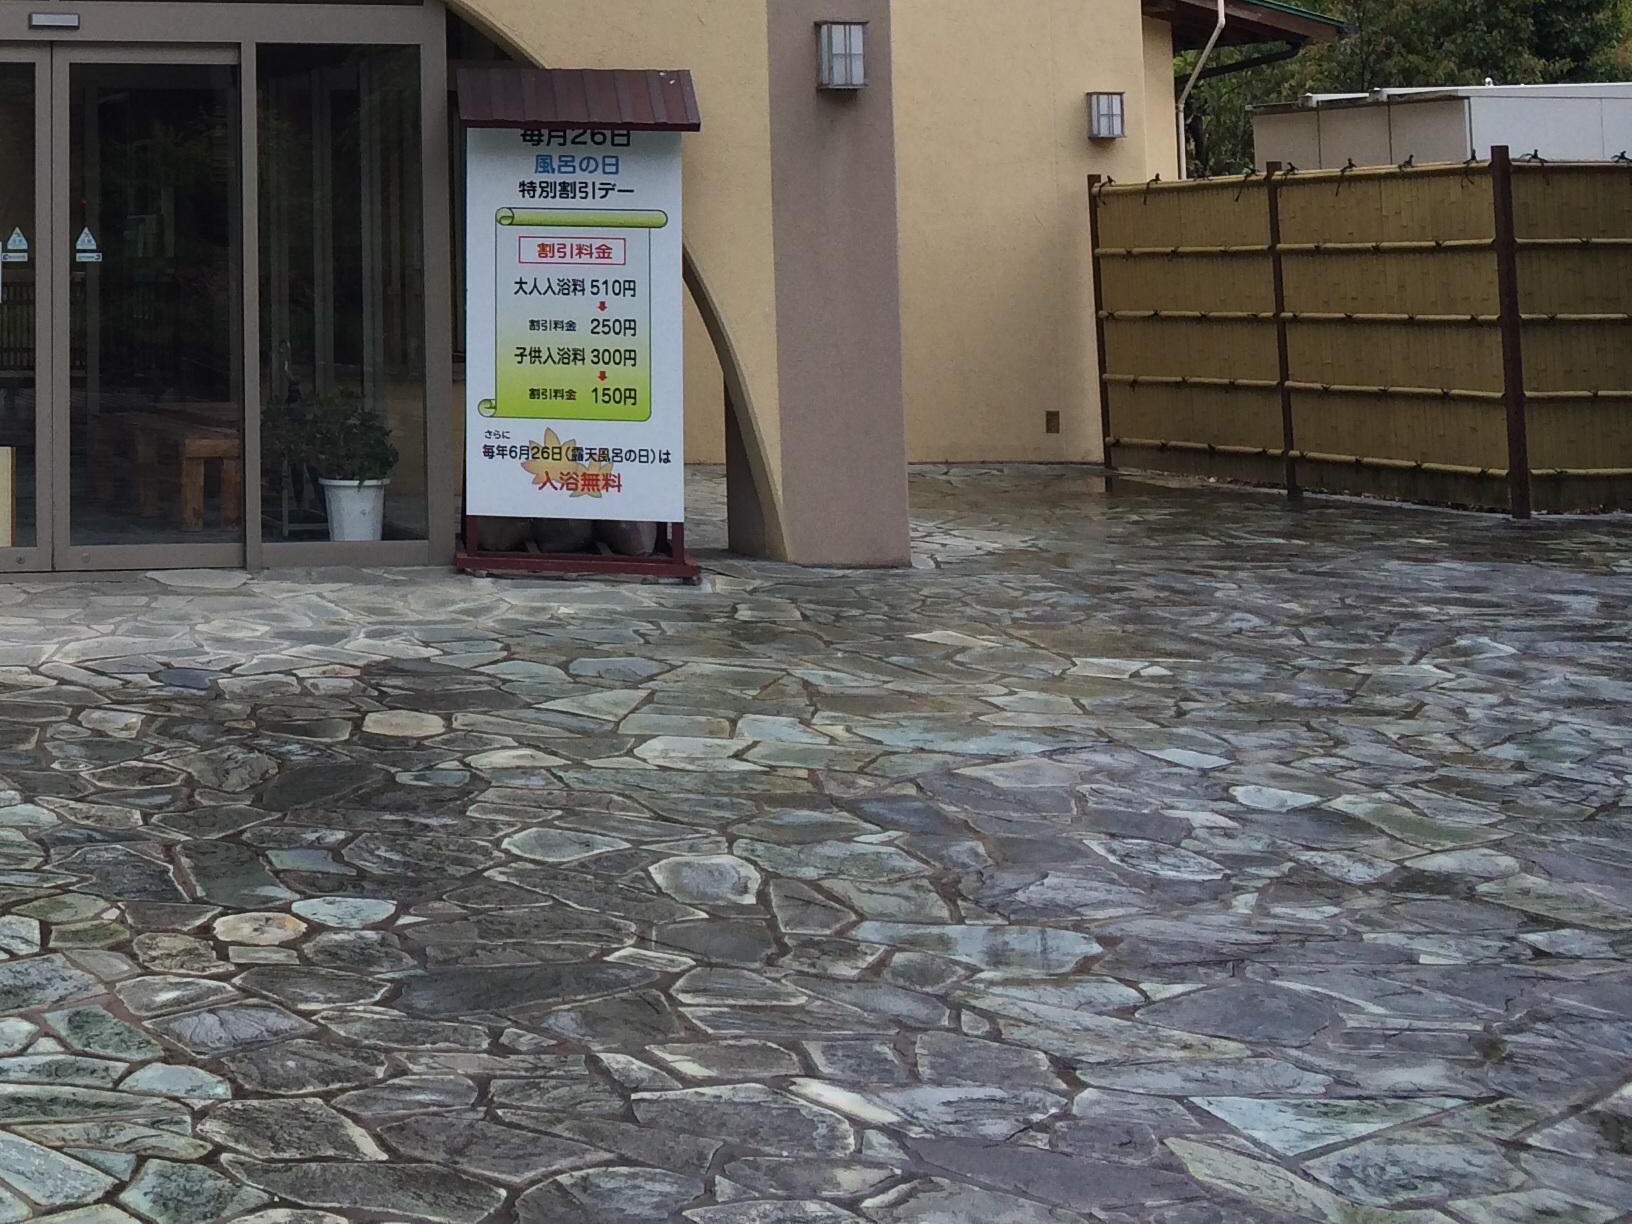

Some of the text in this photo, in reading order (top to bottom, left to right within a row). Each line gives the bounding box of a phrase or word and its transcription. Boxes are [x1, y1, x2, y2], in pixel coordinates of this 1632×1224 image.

[520, 128, 631, 147] 毎月26日
[534, 155, 620, 175] 風呂の日
[518, 181, 635, 200] 特別割引デー
[537, 243, 613, 260] 割引料金
[513, 277, 637, 297] 大人入浴料 510円
[528, 319, 637, 337] 割引料金 250円
[514, 347, 637, 367] 子供入浴料 300円
[528, 387, 637, 406] 割引料金 150円
[484, 430, 511, 440] さらに
[538, 471, 623, 493] 入浴無料
